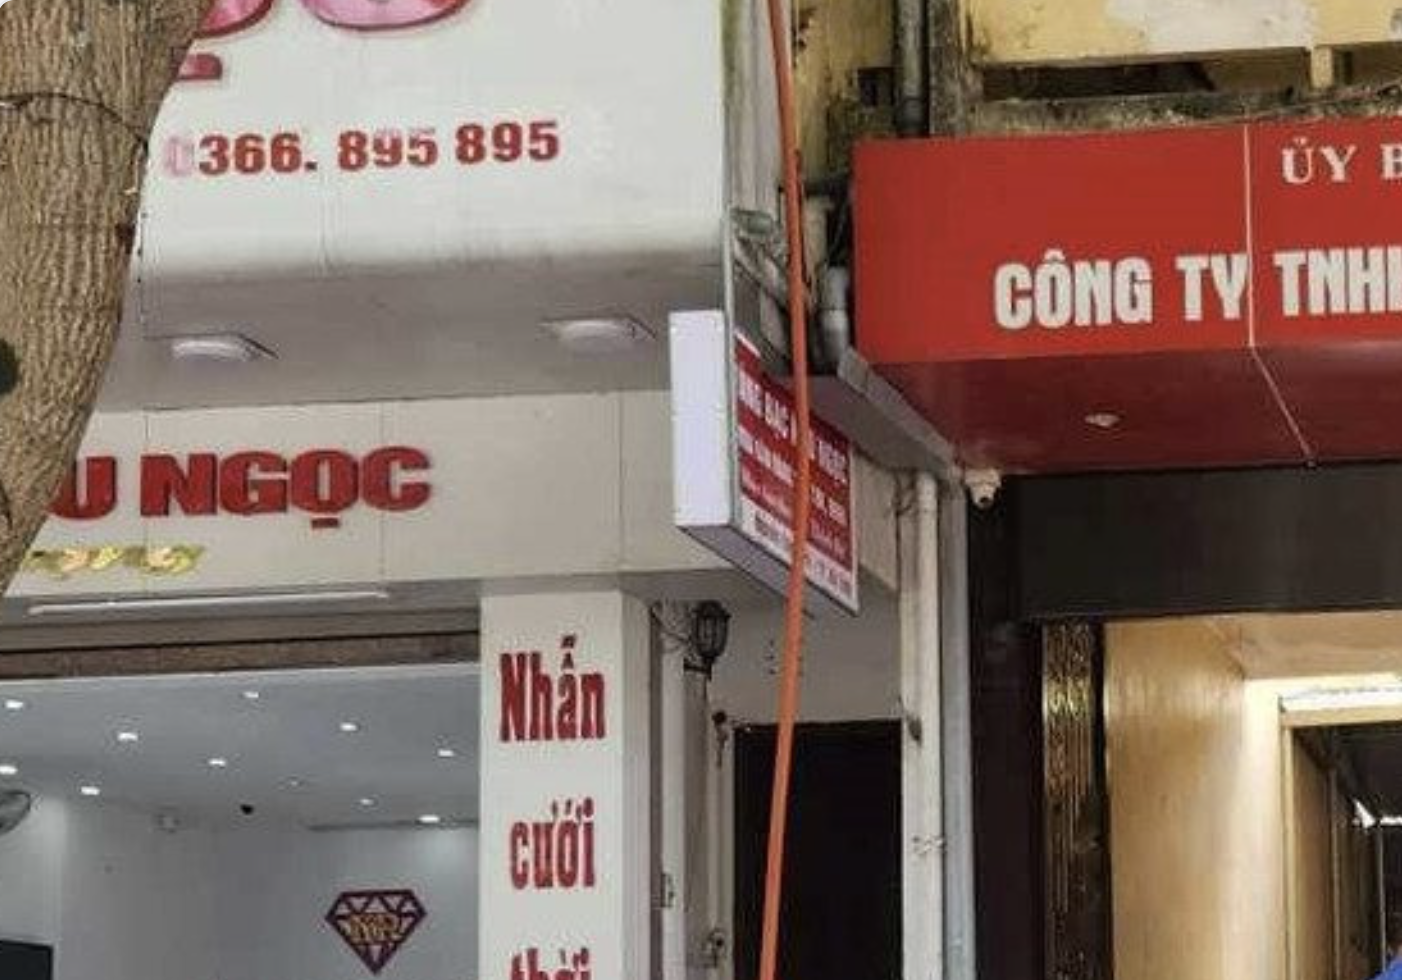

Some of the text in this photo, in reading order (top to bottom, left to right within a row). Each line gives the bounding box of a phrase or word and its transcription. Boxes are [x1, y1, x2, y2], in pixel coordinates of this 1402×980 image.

[338, 128, 439, 172] 895
[455, 120, 560, 164] 895
[1281, 136, 1356, 184] ỦY
[995, 249, 1153, 328] CÔNG
[1176, 254, 1250, 320] TY
[140, 446, 432, 528] NGỌC
[499, 634, 606, 742] Nhẫn
[510, 797, 595, 889] cưới
